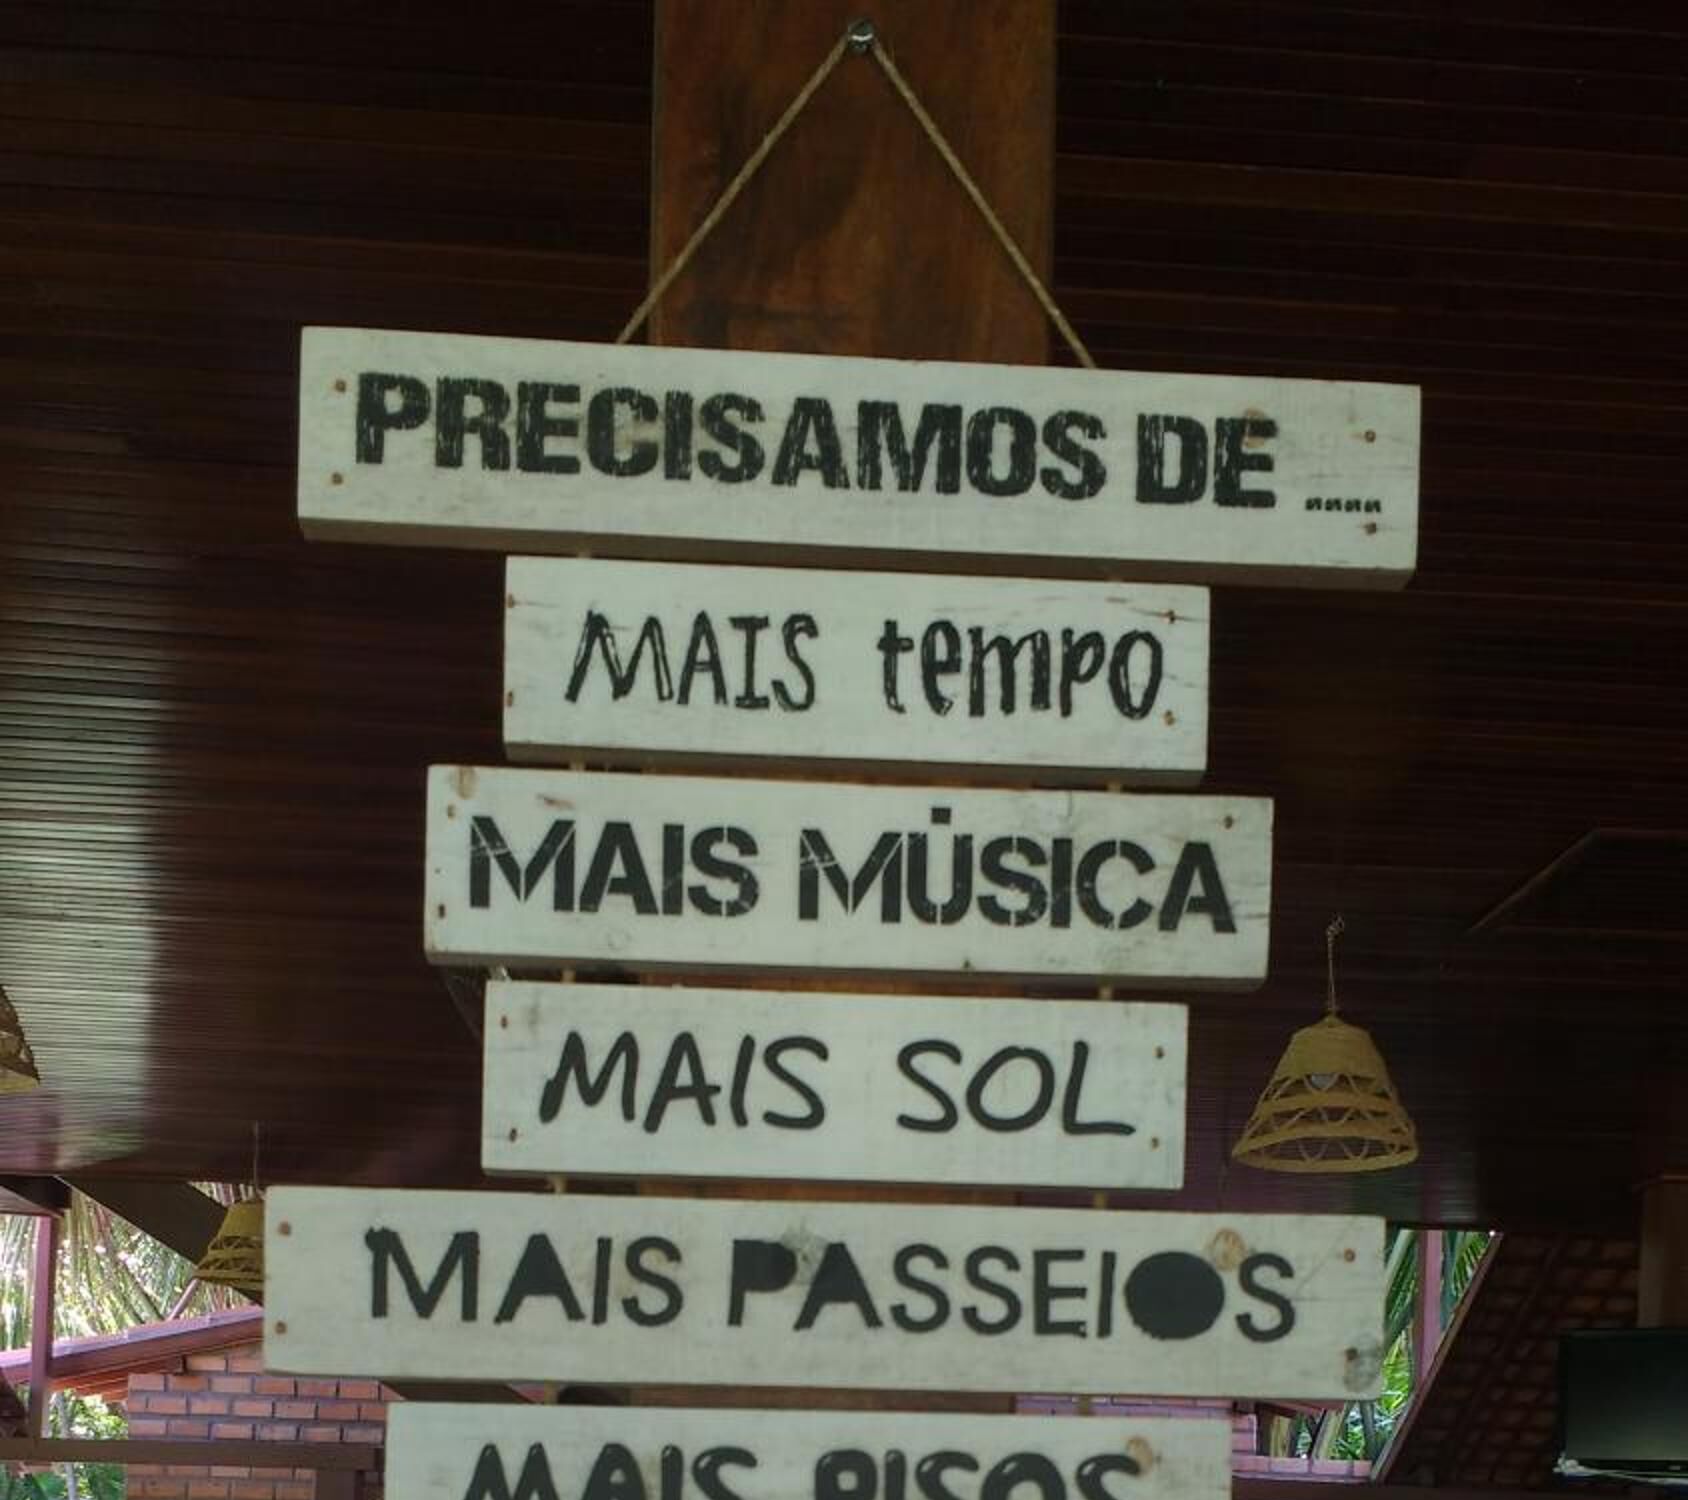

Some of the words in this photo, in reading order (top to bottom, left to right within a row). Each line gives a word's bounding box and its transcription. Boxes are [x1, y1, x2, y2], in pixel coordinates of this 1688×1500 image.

[355, 372, 1108, 501] PRECISAMOS
[1135, 413, 1279, 509] DE
[564, 609, 819, 712] MAIS
[469, 815, 760, 918] MAIS
[538, 1030, 829, 1134] MAIS
[896, 1039, 1137, 1137] SOL
[364, 1226, 684, 1328] MAIS
[727, 1238, 1296, 1344] PASSEIOS
